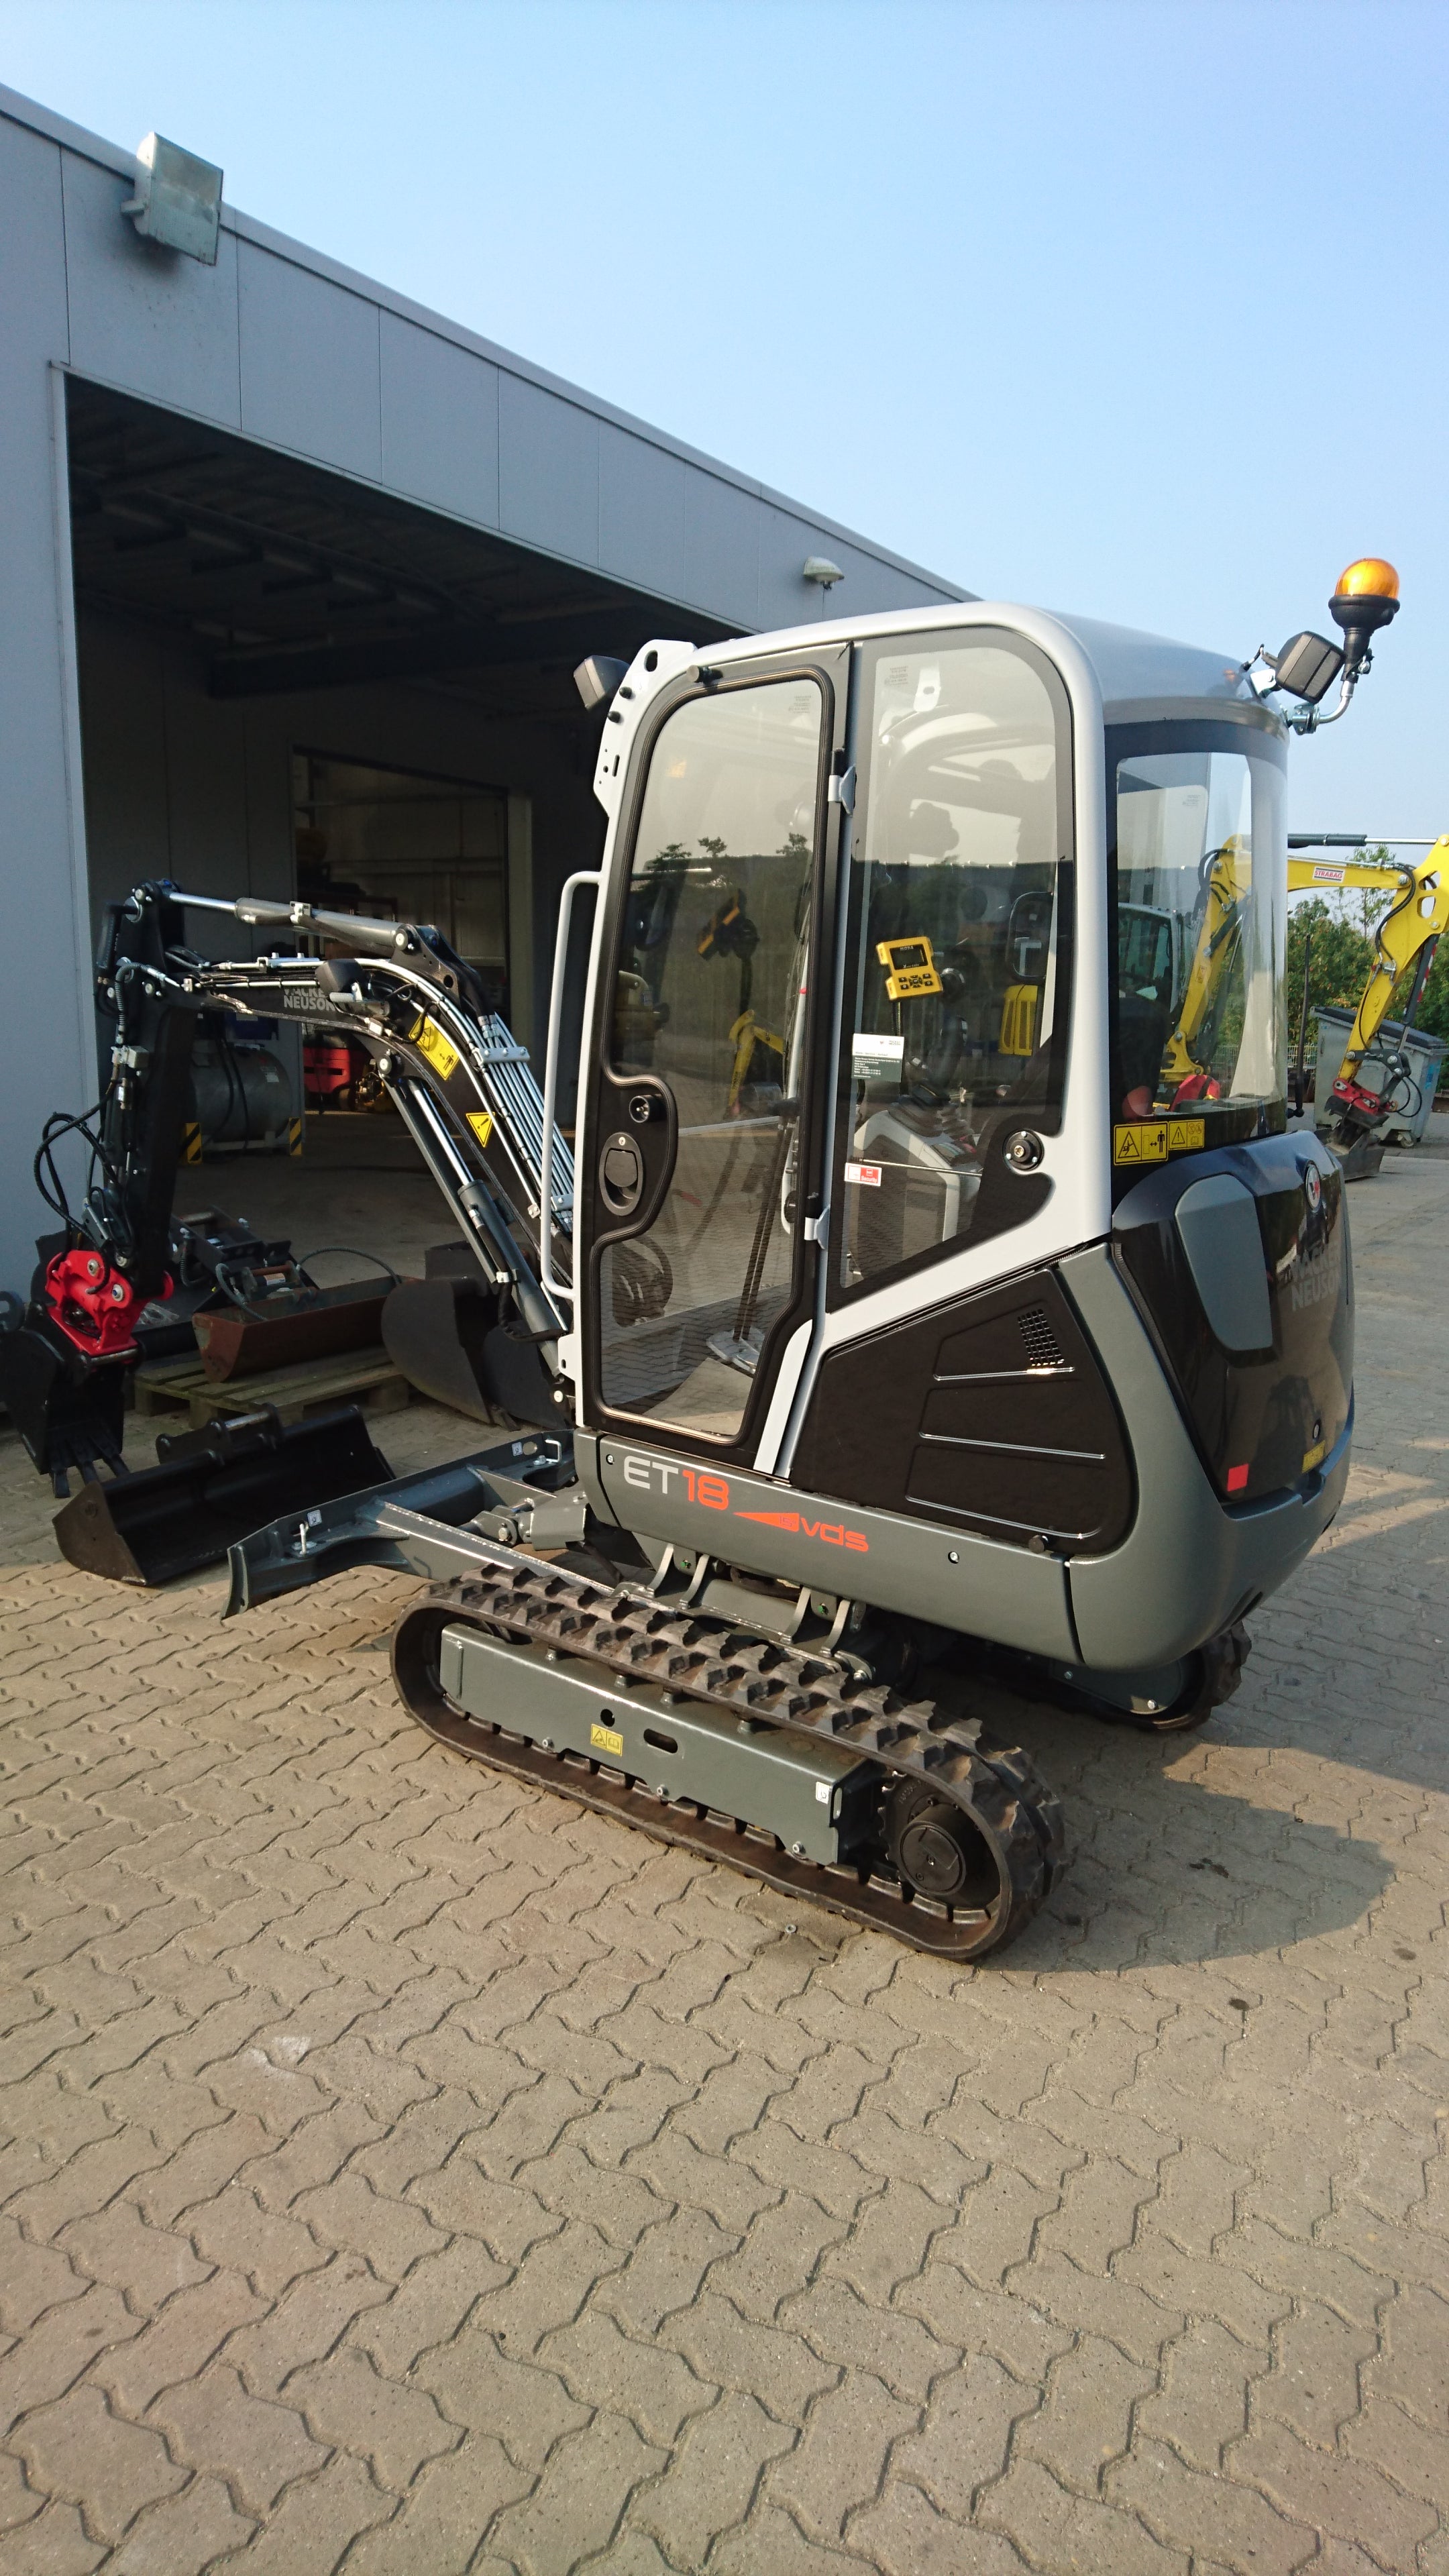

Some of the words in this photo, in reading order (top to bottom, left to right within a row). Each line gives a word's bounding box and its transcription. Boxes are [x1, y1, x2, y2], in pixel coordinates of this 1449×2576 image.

[1314, 870, 1342, 879] STRABAG
[283, 995, 335, 1012] NEUSON
[861, 1175, 877, 1183] Security
[800, 1517, 869, 1552] vds
